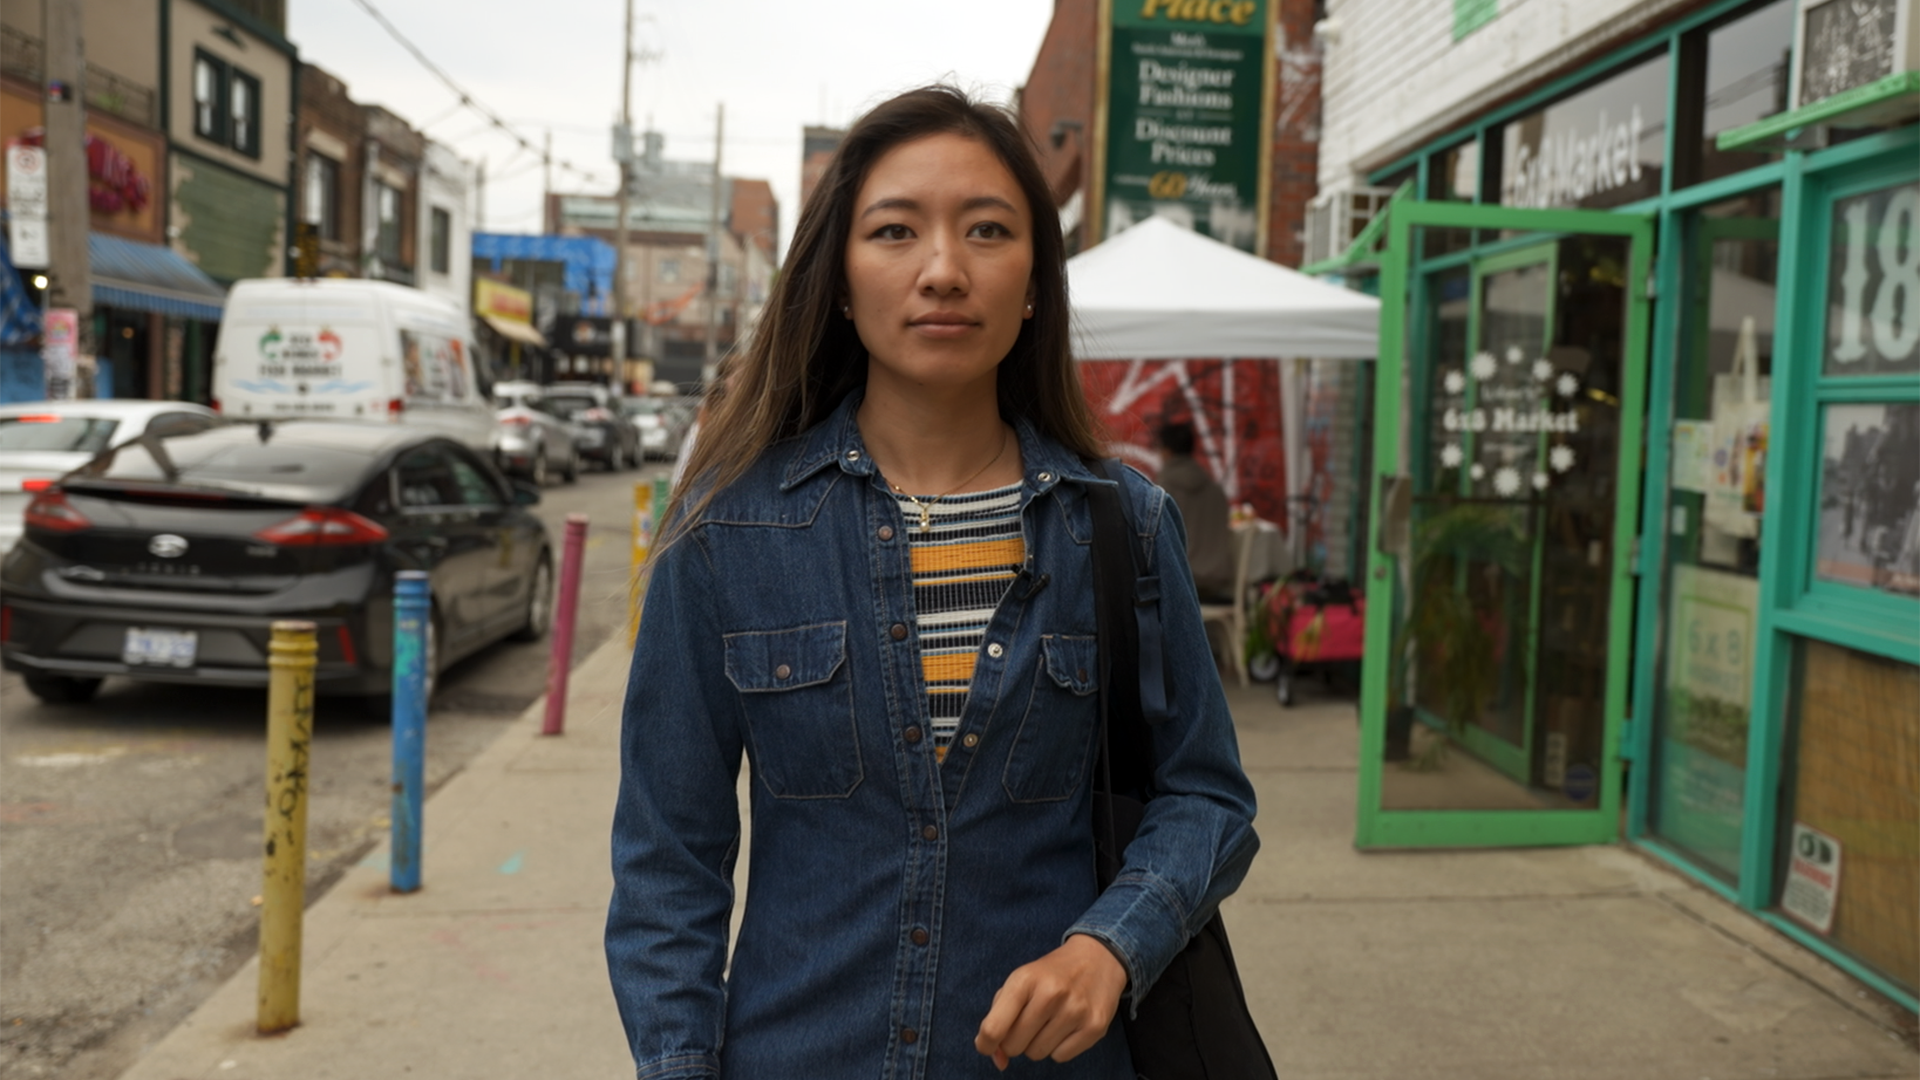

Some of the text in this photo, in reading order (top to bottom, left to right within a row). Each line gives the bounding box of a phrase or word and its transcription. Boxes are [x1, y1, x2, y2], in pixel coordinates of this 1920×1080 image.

[1140, 0, 1256, 25] Place
[1138, 60, 1235, 88] Designer
[1138, 84, 1233, 110] Fashions
[1135, 118, 1232, 146] Discount
[1150, 142, 1216, 167] Prices
[1553, 103, 1644, 206] Market
[1148, 171, 1188, 200] 60
[1491, 407, 1580, 433] Market
